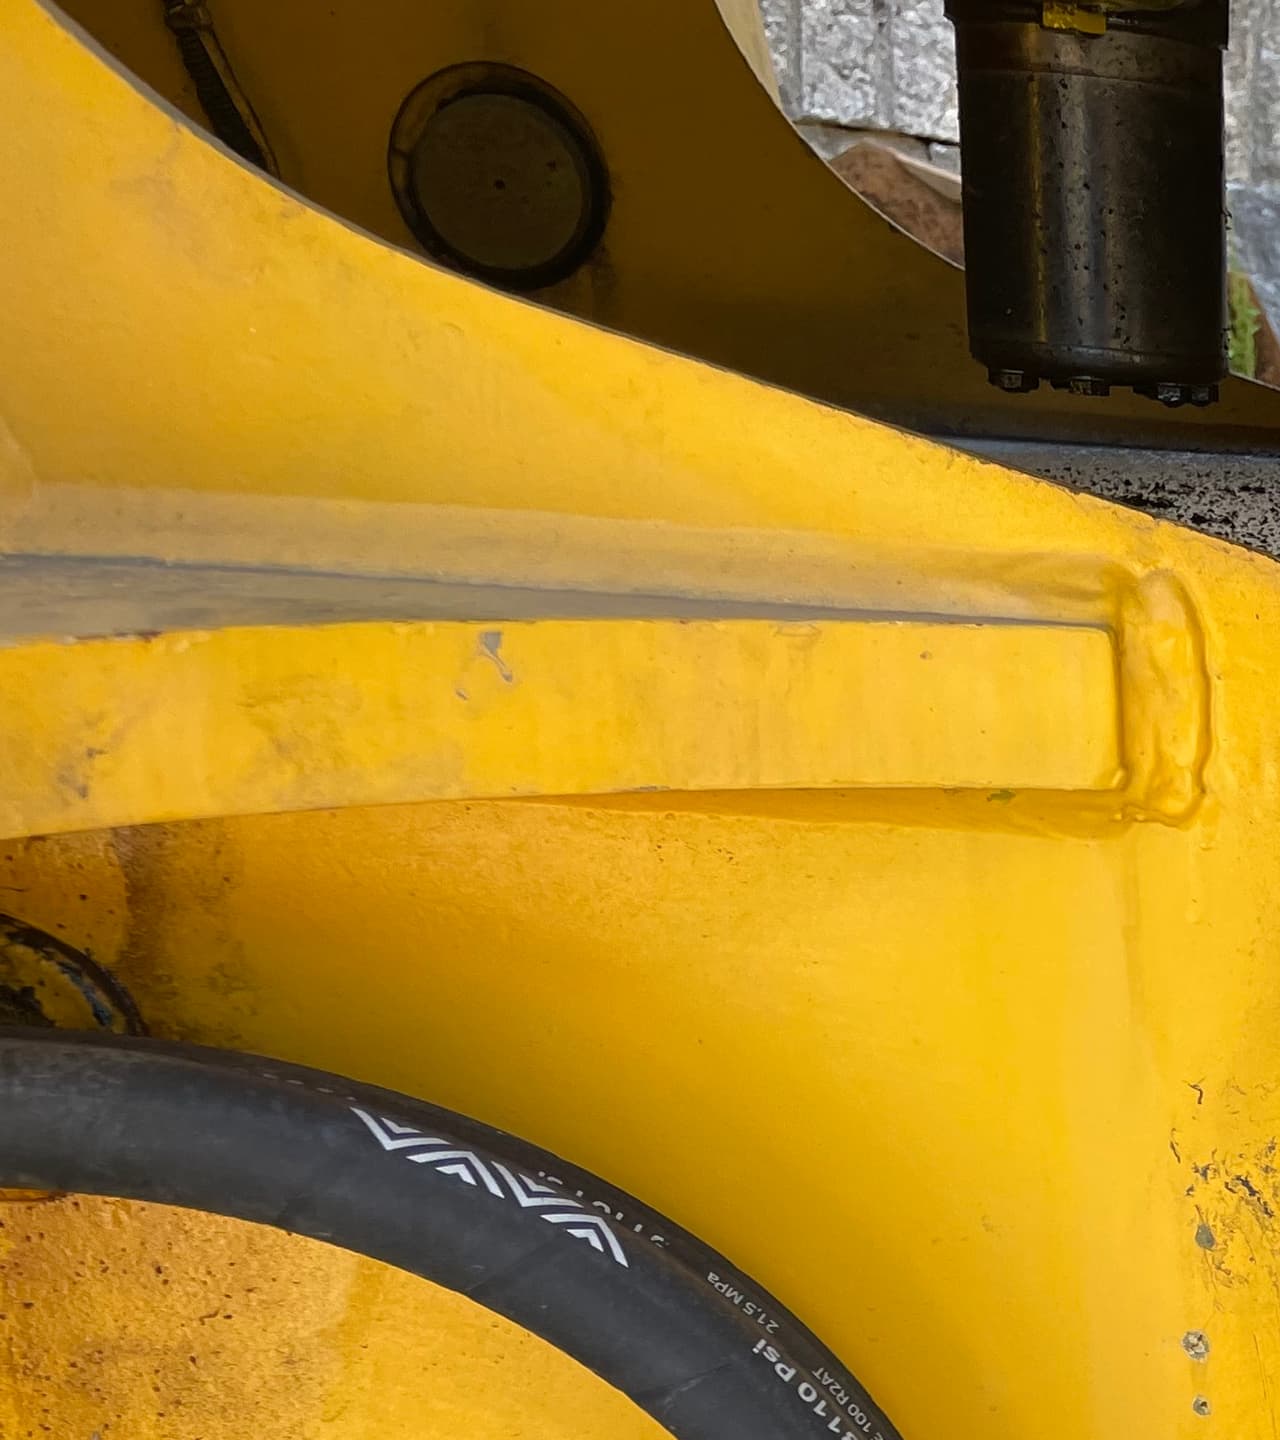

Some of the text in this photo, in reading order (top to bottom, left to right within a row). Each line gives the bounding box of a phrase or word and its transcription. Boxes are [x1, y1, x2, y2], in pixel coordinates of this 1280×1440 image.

[707, 1271, 743, 1305] MPa
[752, 1338, 796, 1383] Psi
[811, 1367, 850, 1406] R2AT
[847, 1403, 872, 1433] 100
